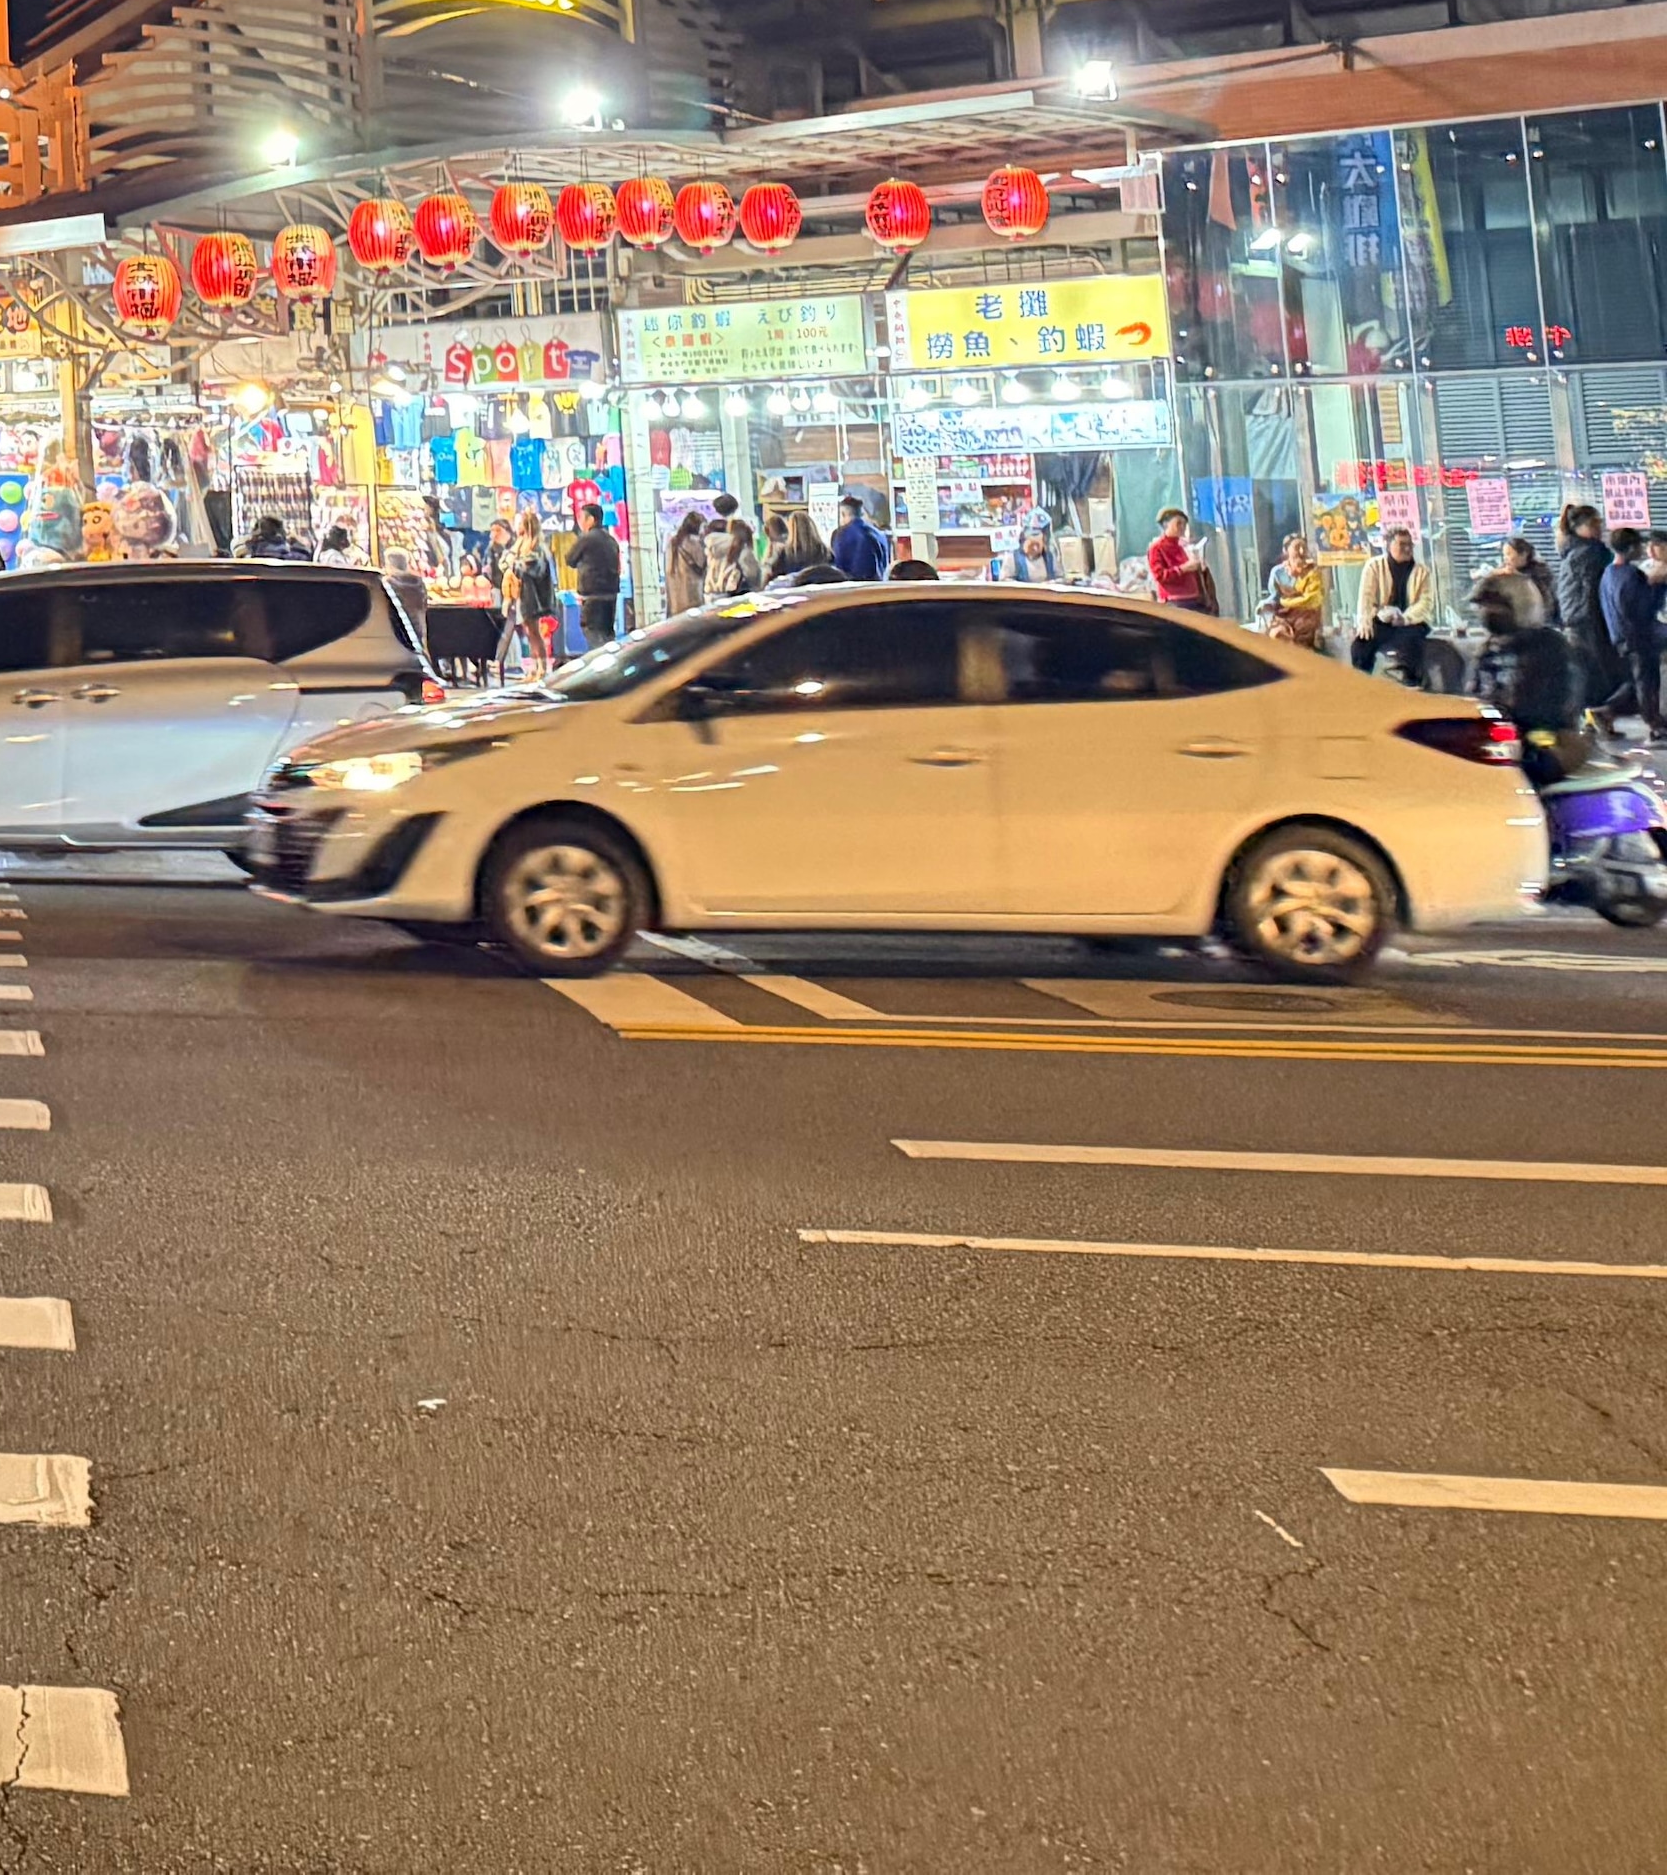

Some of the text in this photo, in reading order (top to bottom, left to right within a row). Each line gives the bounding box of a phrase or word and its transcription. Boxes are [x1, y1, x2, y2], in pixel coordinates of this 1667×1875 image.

[975, 289, 1049, 321] 老攤
[927, 323, 1106, 360] 撈魚、釣蝦
